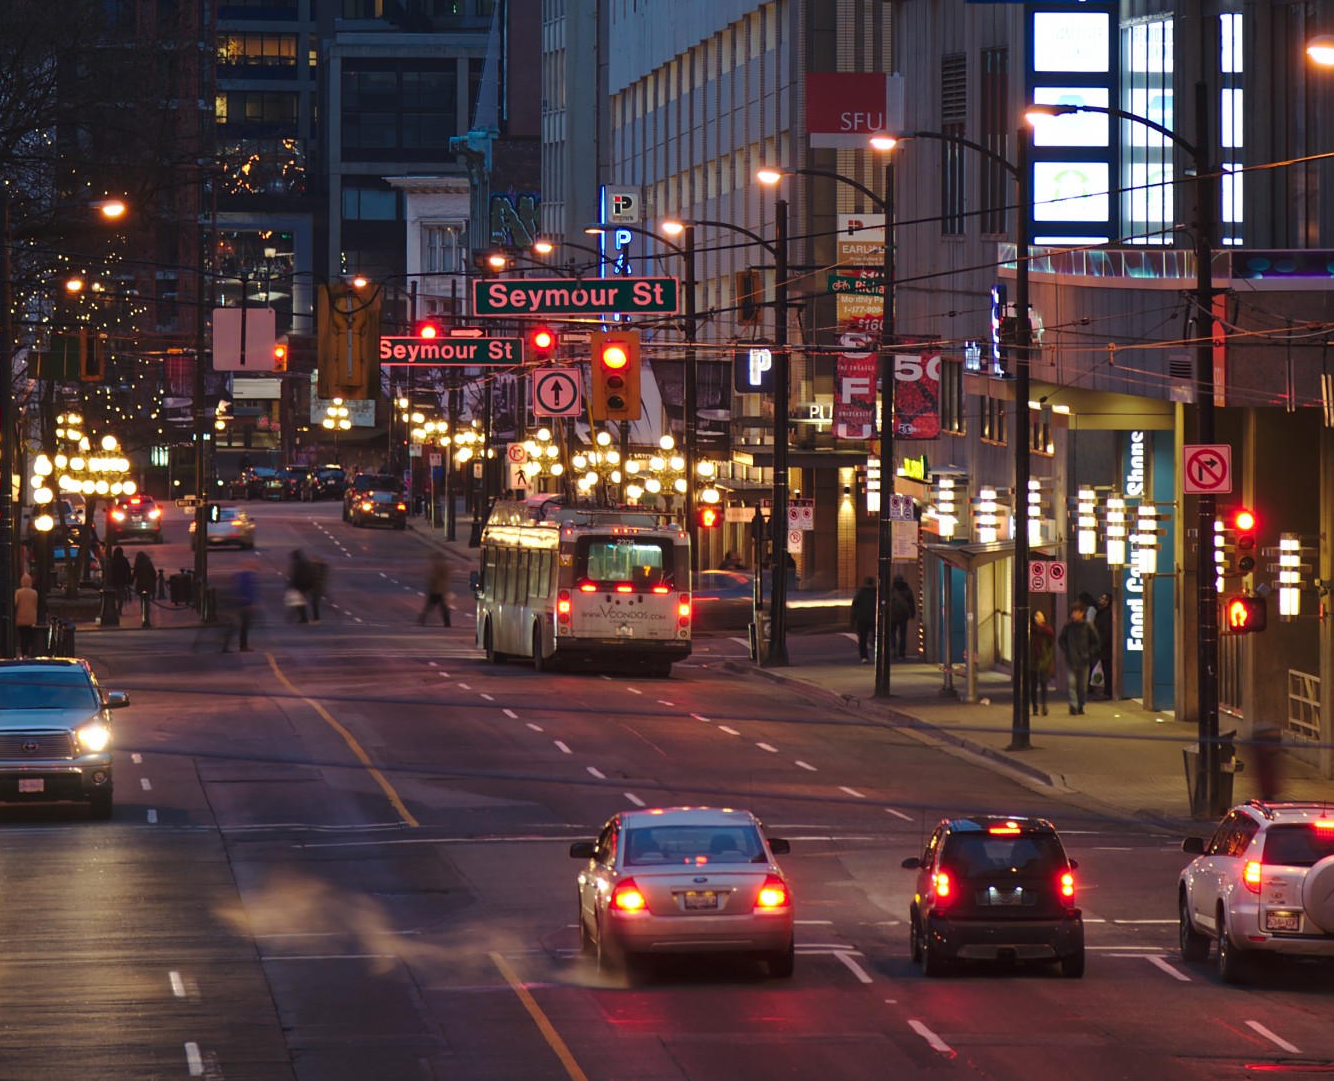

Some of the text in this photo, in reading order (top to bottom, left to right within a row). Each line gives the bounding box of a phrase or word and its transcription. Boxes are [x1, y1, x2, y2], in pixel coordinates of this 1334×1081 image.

[841, 112, 883, 131] SFU
[488, 282, 664, 311] Seymour St
[380, 340, 513, 362] Seymour St
[749, 348, 772, 385] P
